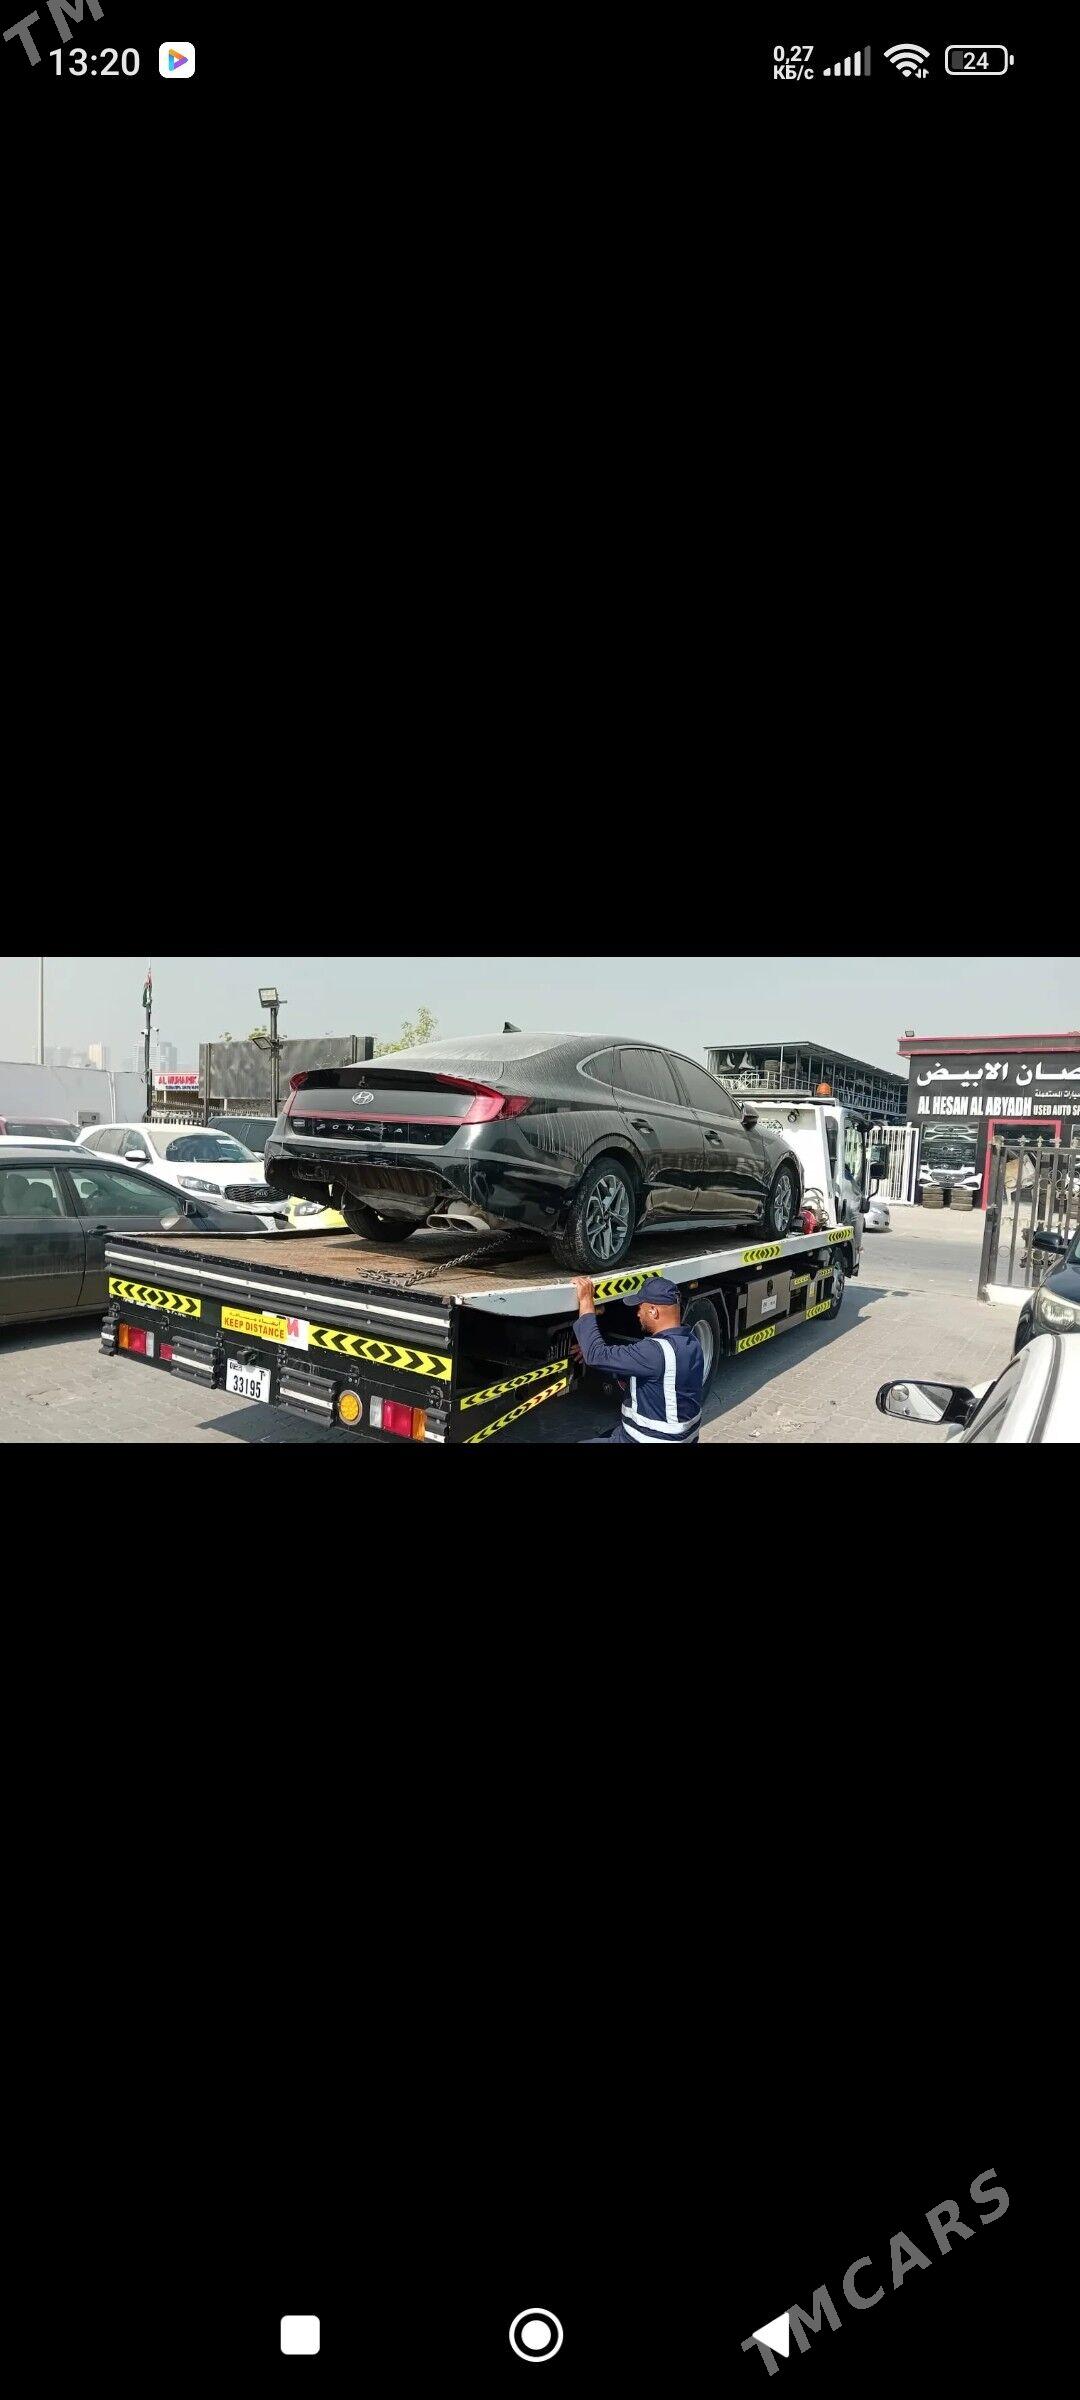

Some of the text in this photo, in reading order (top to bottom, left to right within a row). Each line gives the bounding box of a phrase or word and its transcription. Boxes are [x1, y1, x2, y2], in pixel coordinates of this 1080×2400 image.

[49, 48, 140, 76] 13:20
[773, 45, 814, 64] 0,27
[963, 51, 990, 70] 24
[773, 64, 814, 80] КБ/с
[917, 1096, 1032, 1117] AL HESAN AL ABYADH
[1033, 1104, 1052, 1116] USED
[1052, 1104, 1071, 1116] AUTO
[316, 1123, 403, 1135] SONATA
[224, 1317, 244, 1328] KEEP
[245, 1321, 285, 1339] DISTANCE
[233, 1375, 261, 1398] 33195
